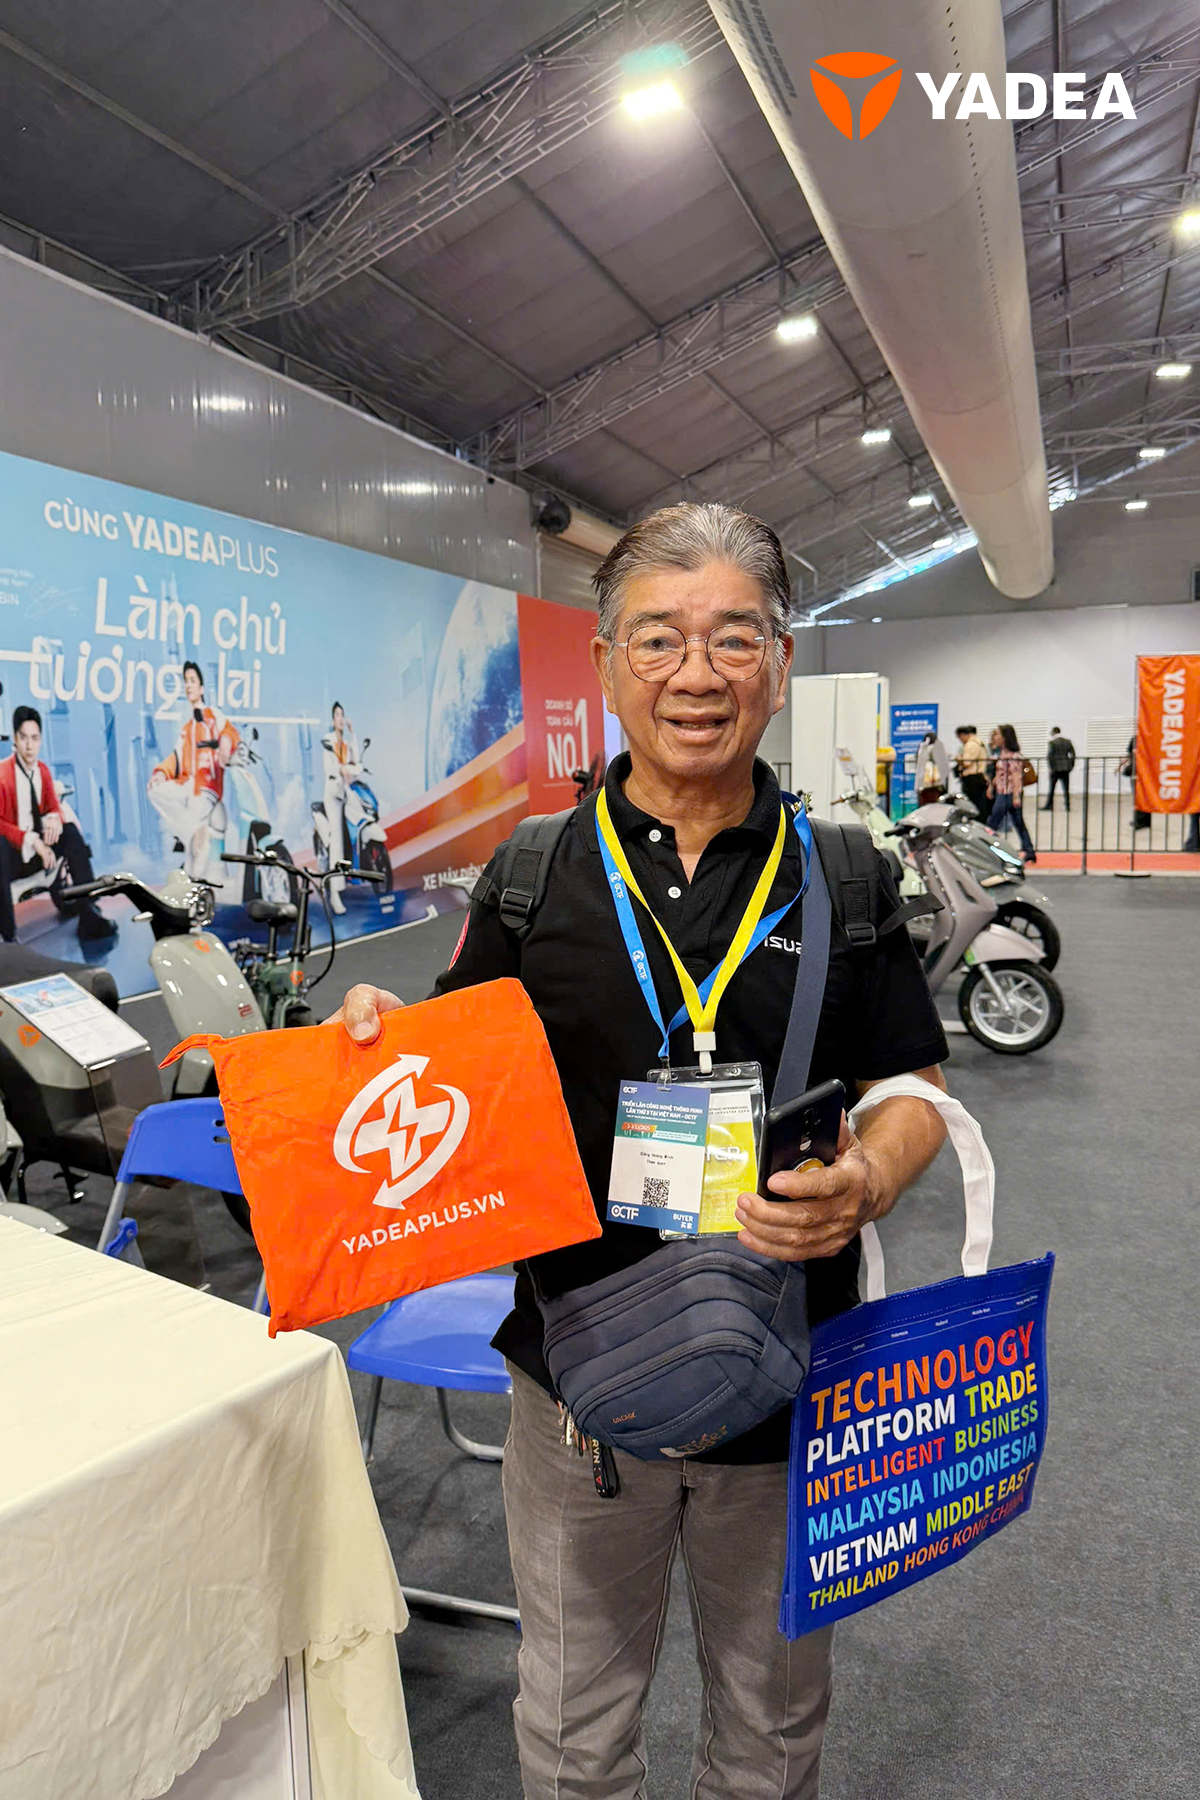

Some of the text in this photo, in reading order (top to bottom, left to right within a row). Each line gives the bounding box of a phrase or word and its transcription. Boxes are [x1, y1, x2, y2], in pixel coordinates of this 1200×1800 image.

[44, 497, 280, 578] CÙNG YADEAPLUS
[95, 574, 286, 656] Làm chủ
[216, 652, 262, 709] lai
[1158, 668, 1186, 800] YADEAPLUS
[422, 874, 438, 892] XE
[341, 1190, 506, 1255] YADEAPLUS.VN
[610, 1204, 640, 1221] OCTF
[672, 1213, 694, 1222] BUYER
[806, 1362, 1037, 1473] PLATFORM TRADE
[811, 1320, 1035, 1431] TECHNOLOGY
[806, 1400, 1039, 1507] INTELLIGENT BUSINESS
[808, 1431, 1038, 1546] MALAYSIA INDONESIA
[808, 1462, 1034, 1582] VIETNAM MIDDLE EAST
[808, 1492, 1025, 1610] THAILAND HONG KONG CHINA
